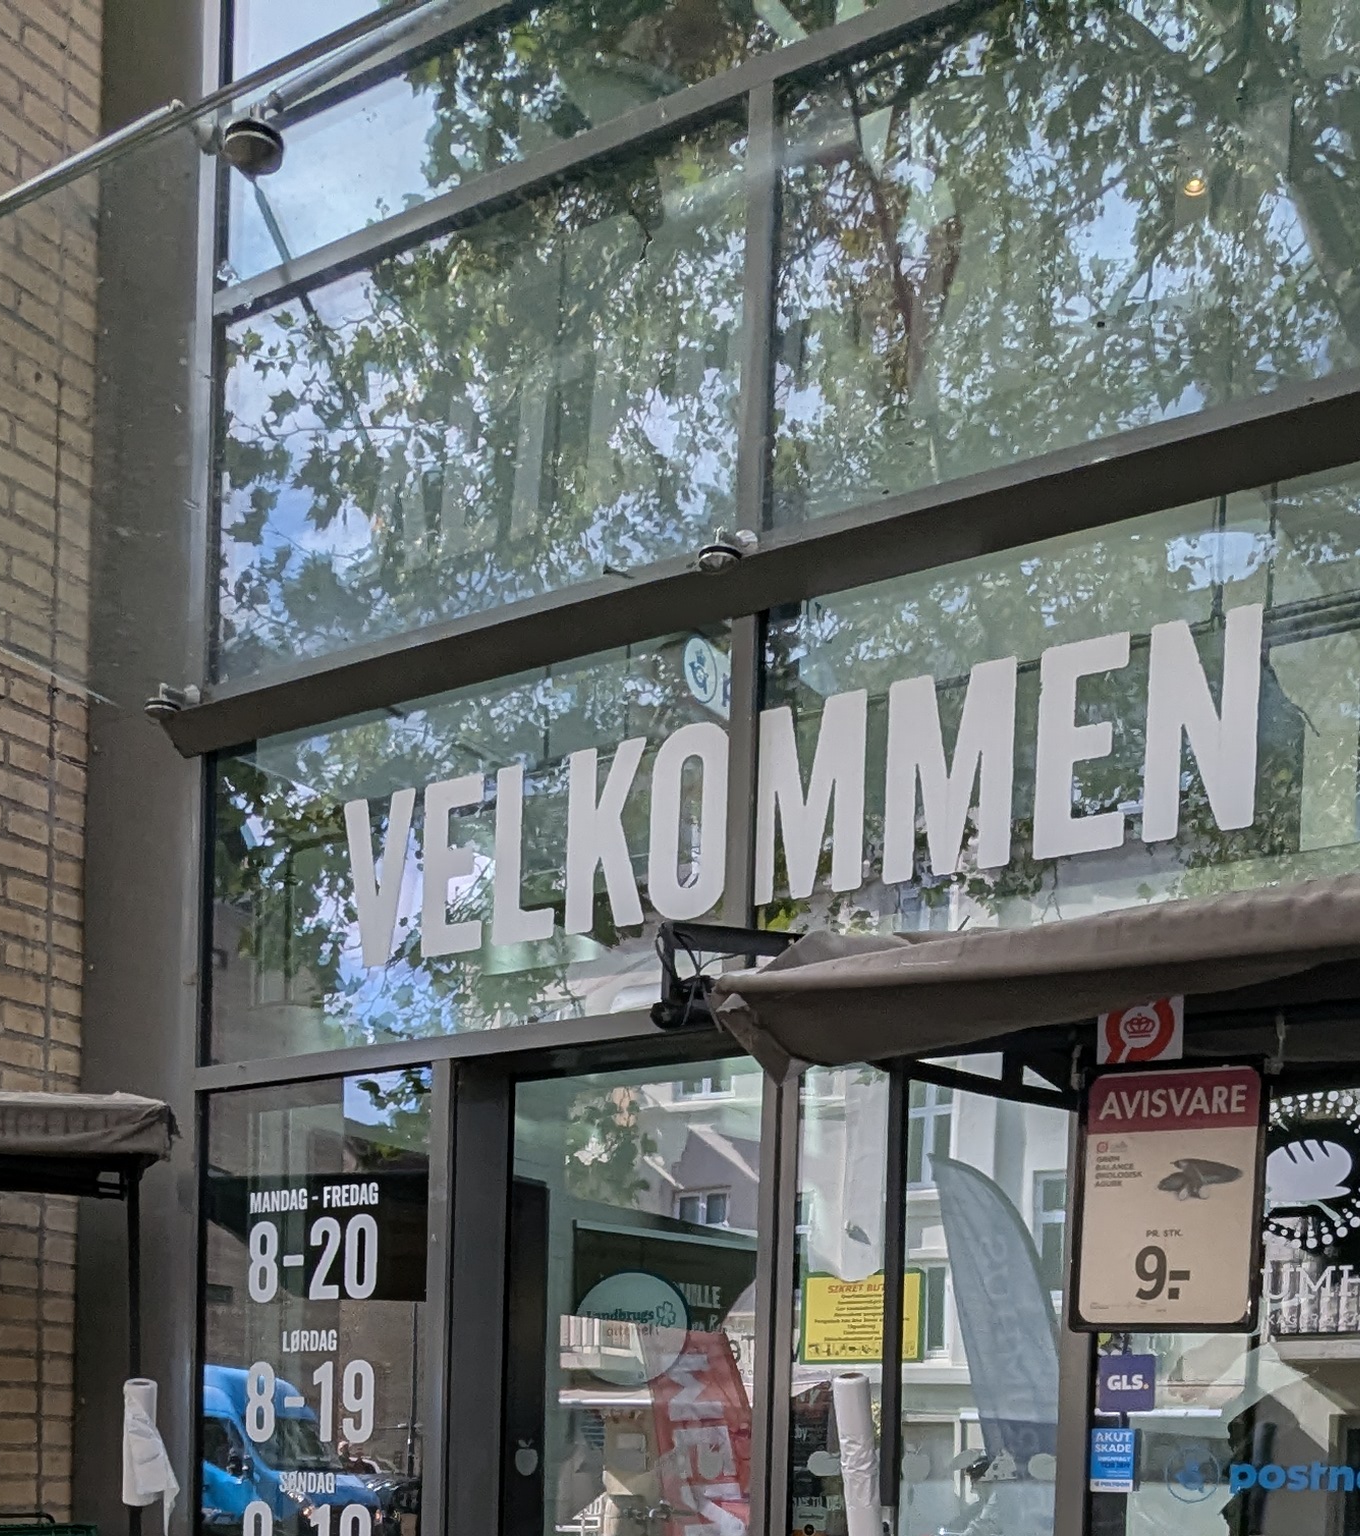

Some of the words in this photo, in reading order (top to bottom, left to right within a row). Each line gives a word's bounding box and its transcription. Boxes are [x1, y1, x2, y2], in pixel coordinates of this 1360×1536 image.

[344, 603, 1264, 968] VELKOMMEN
[1098, 1084, 1248, 1121] AVISVARE
[250, 1188, 308, 1214] MANDAG
[323, 1182, 379, 1208] FREDAG
[248, 1213, 379, 1303] 8-20
[827, 1284, 864, 1294] SIKRET
[282, 1329, 337, 1353] LØRDAG
[246, 1360, 375, 1444] 8-19
[1095, 1432, 1132, 1442] AKUT
[1095, 1443, 1132, 1453] SKADE
[279, 1471, 335, 1494] SØNDAG
